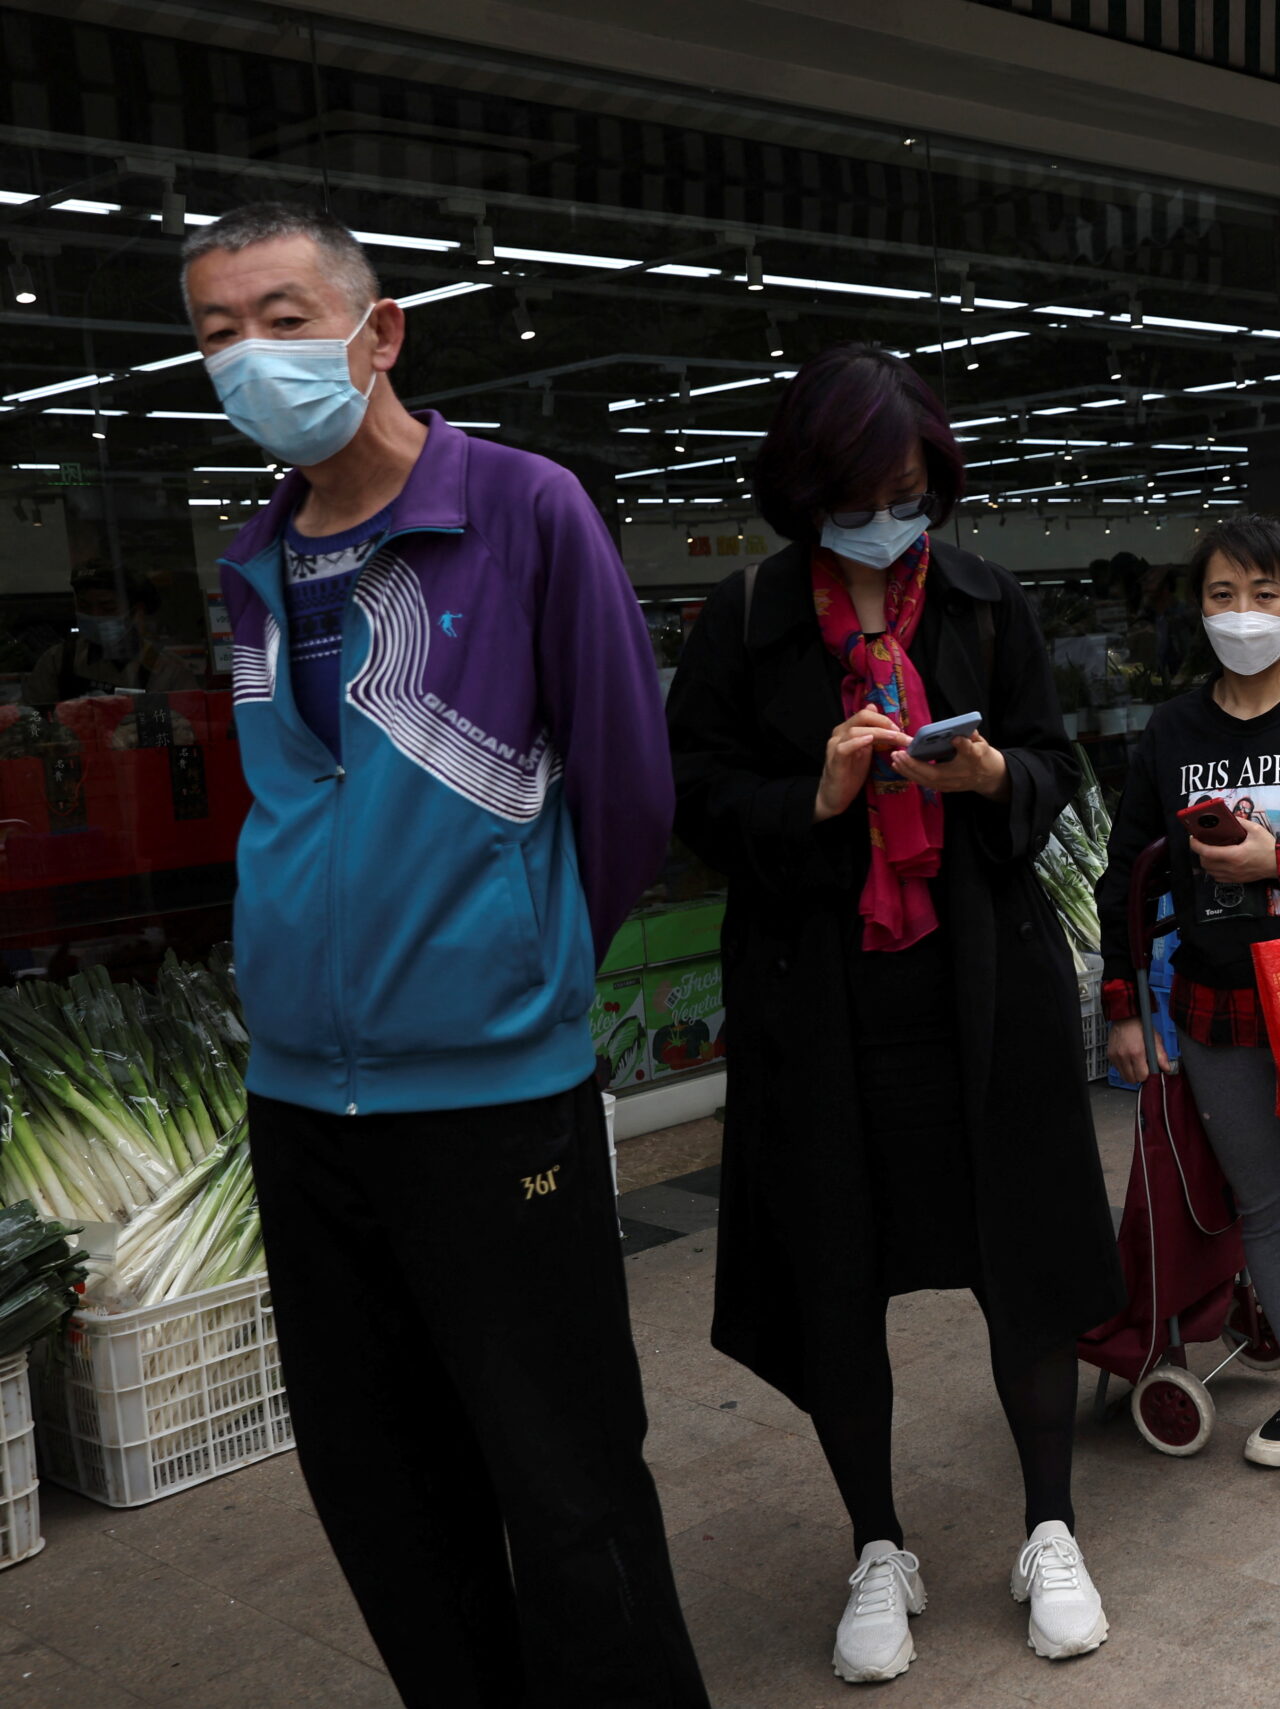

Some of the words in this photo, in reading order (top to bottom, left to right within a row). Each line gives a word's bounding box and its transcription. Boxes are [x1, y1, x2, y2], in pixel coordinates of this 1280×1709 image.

[422, 692, 516, 760] QIAODAN
[1179, 759, 1230, 796] IRIS
[1205, 908, 1223, 917] Tour
